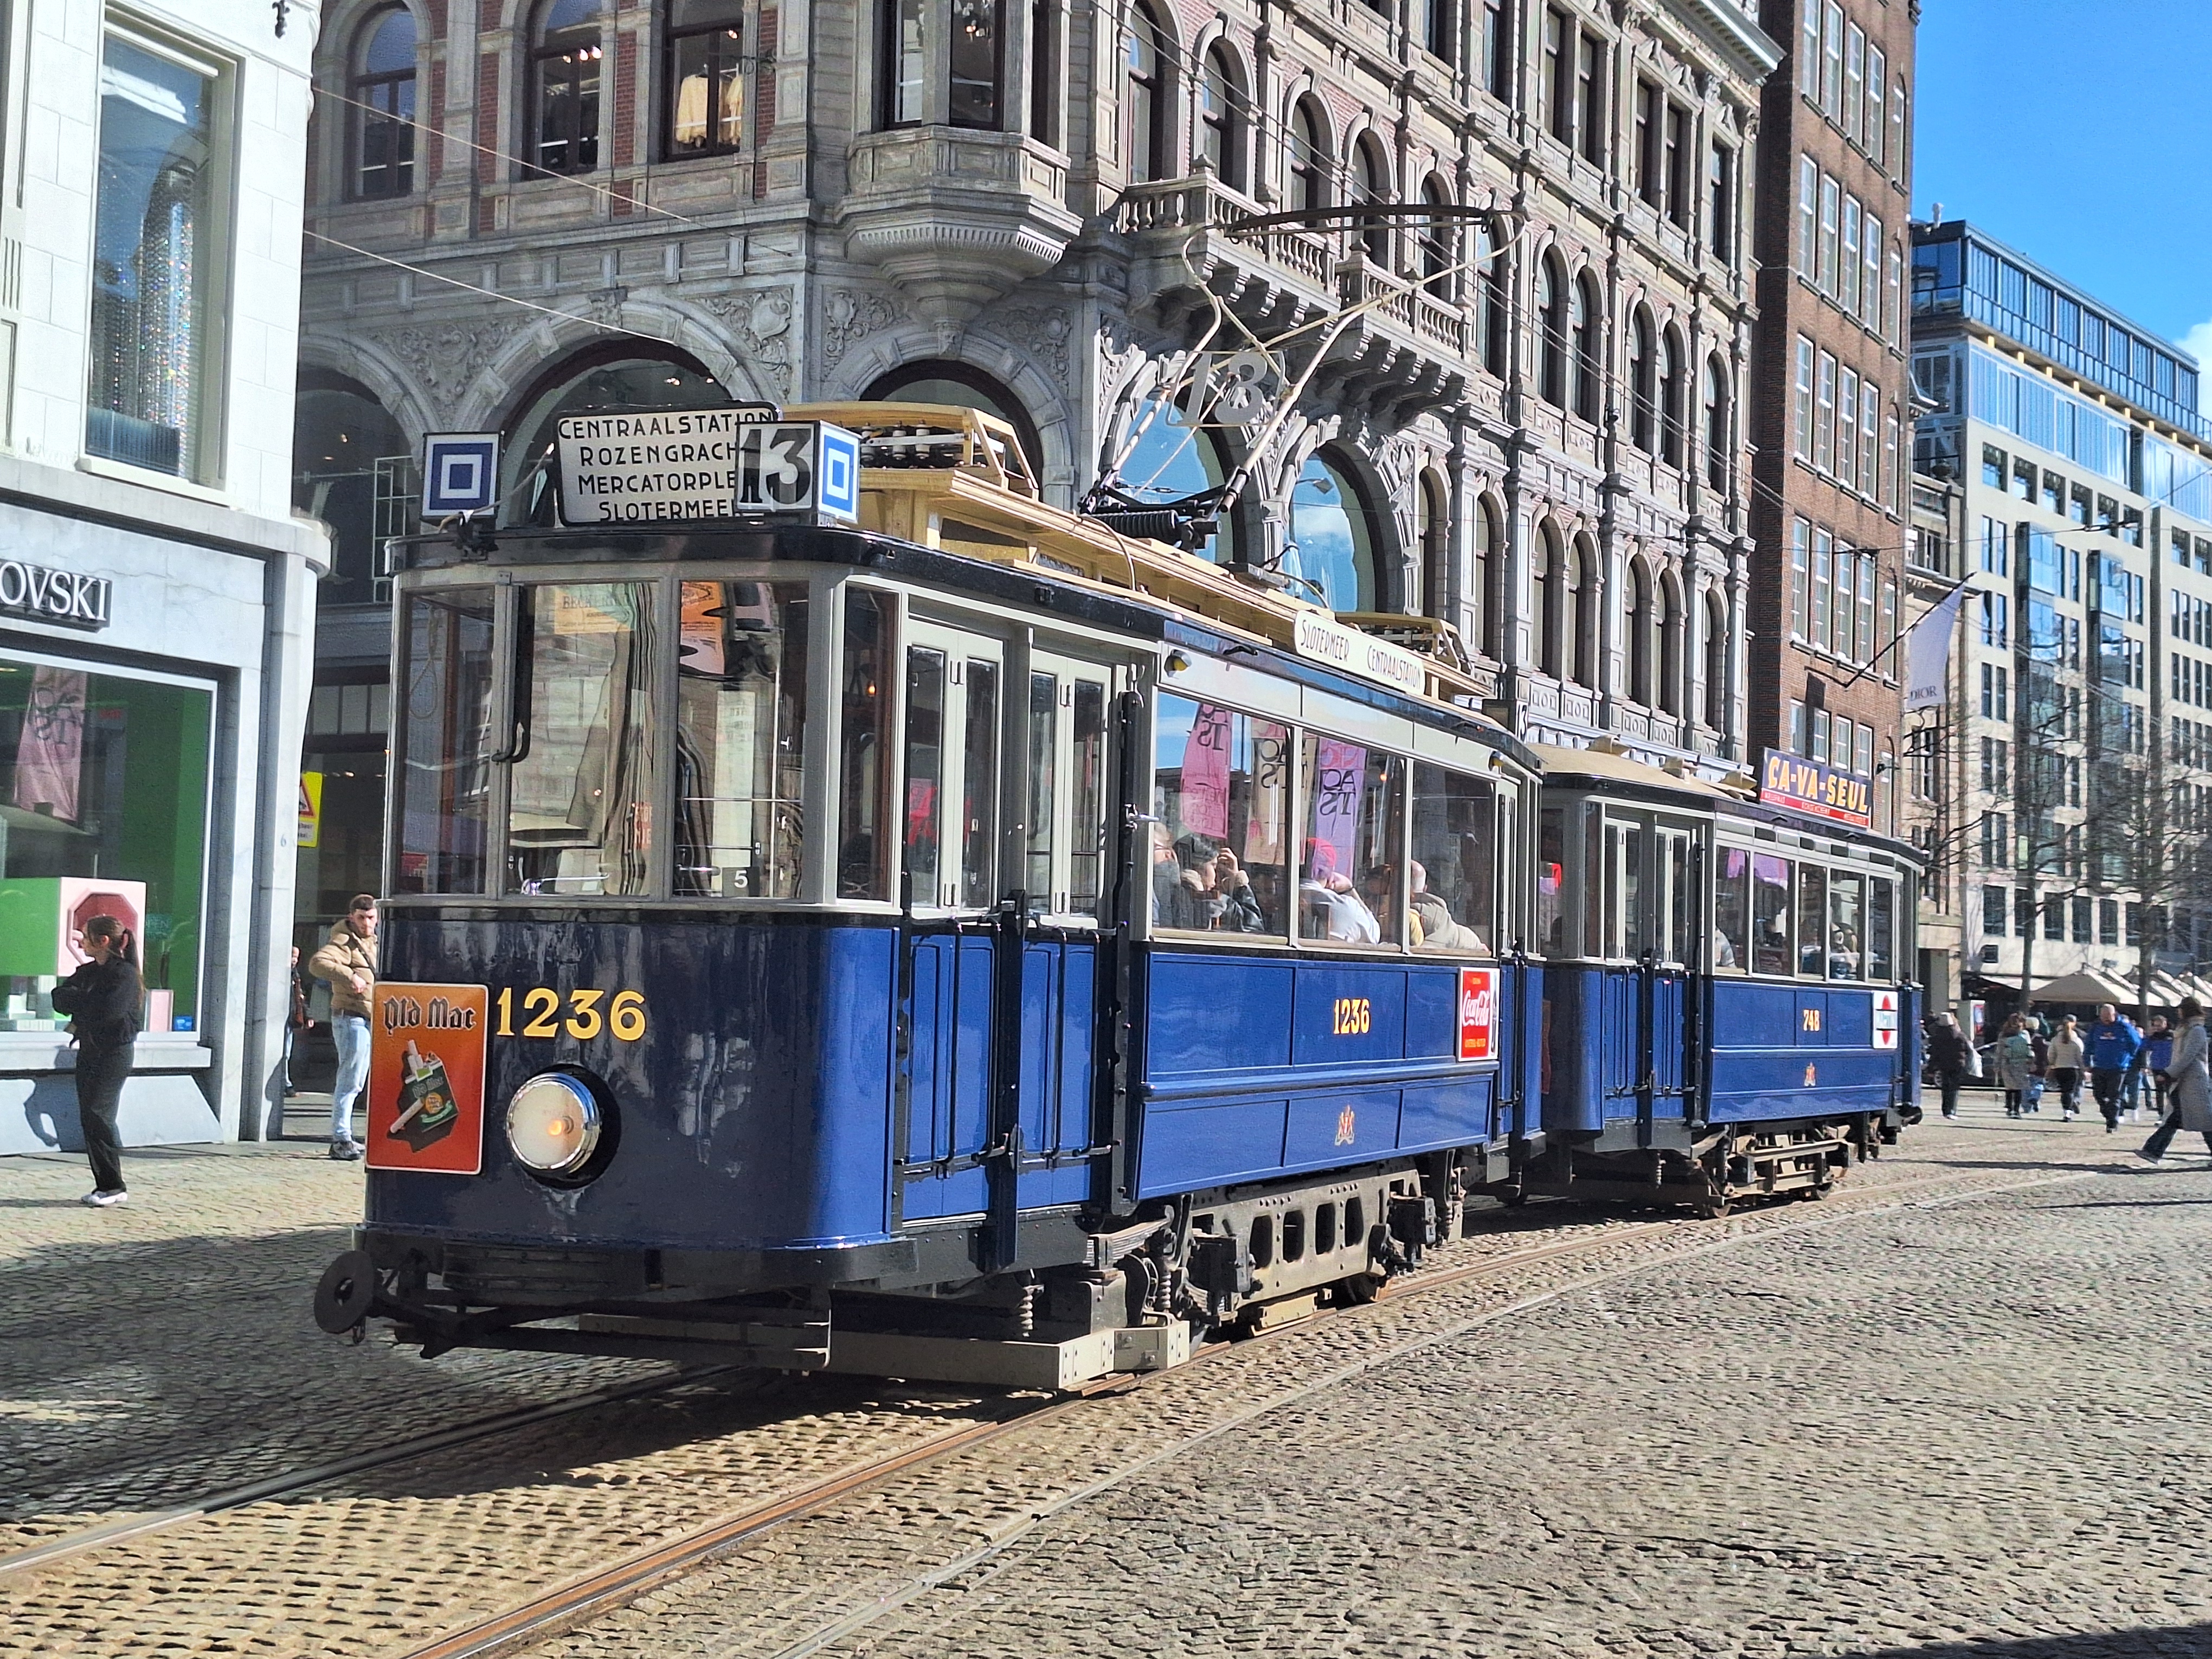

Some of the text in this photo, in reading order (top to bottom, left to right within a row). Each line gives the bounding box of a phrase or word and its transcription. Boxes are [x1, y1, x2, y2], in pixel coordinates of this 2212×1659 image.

[580, 442, 736, 466] ROZENGRACH
[740, 428, 812, 505] 13
[578, 471, 735, 494] MERCATORPLE
[0, 562, 109, 621] OVSKI
[1301, 620, 1421, 690] SLOTERMEER CENTRAALSTATION
[1910, 686, 1937, 702] DIOR
[1767, 756, 1869, 813] CA-VA-SEUL
[734, 870, 748, 888] 5
[383, 996, 477, 1037] Old Mac
[496, 987, 646, 1041] 1236
[1333, 999, 1371, 1034] 1236
[1803, 1009, 1820, 1031] 748
